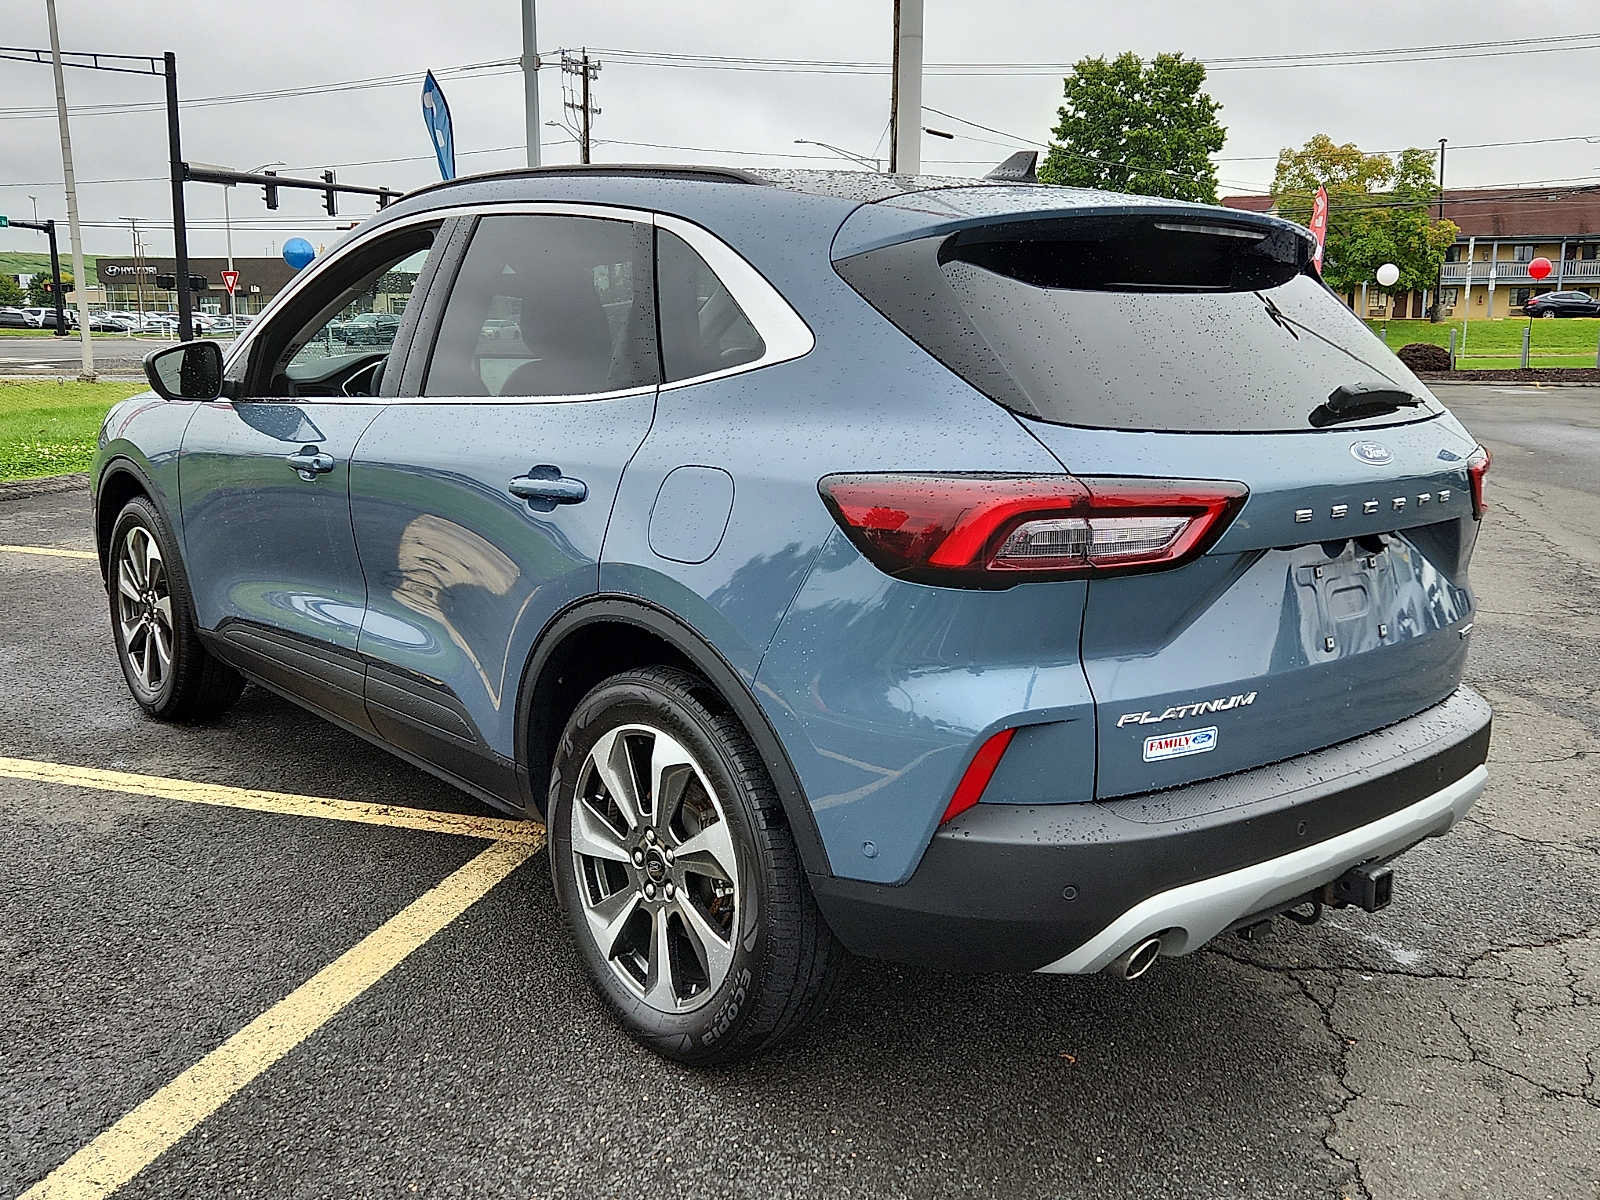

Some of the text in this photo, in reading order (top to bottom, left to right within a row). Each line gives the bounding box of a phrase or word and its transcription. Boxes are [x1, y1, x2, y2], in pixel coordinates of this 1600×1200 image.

[1295, 489, 1451, 524] ESCAPE
[1116, 692, 1258, 727] PLATINUM
[1149, 736, 1192, 752] FAMILY
